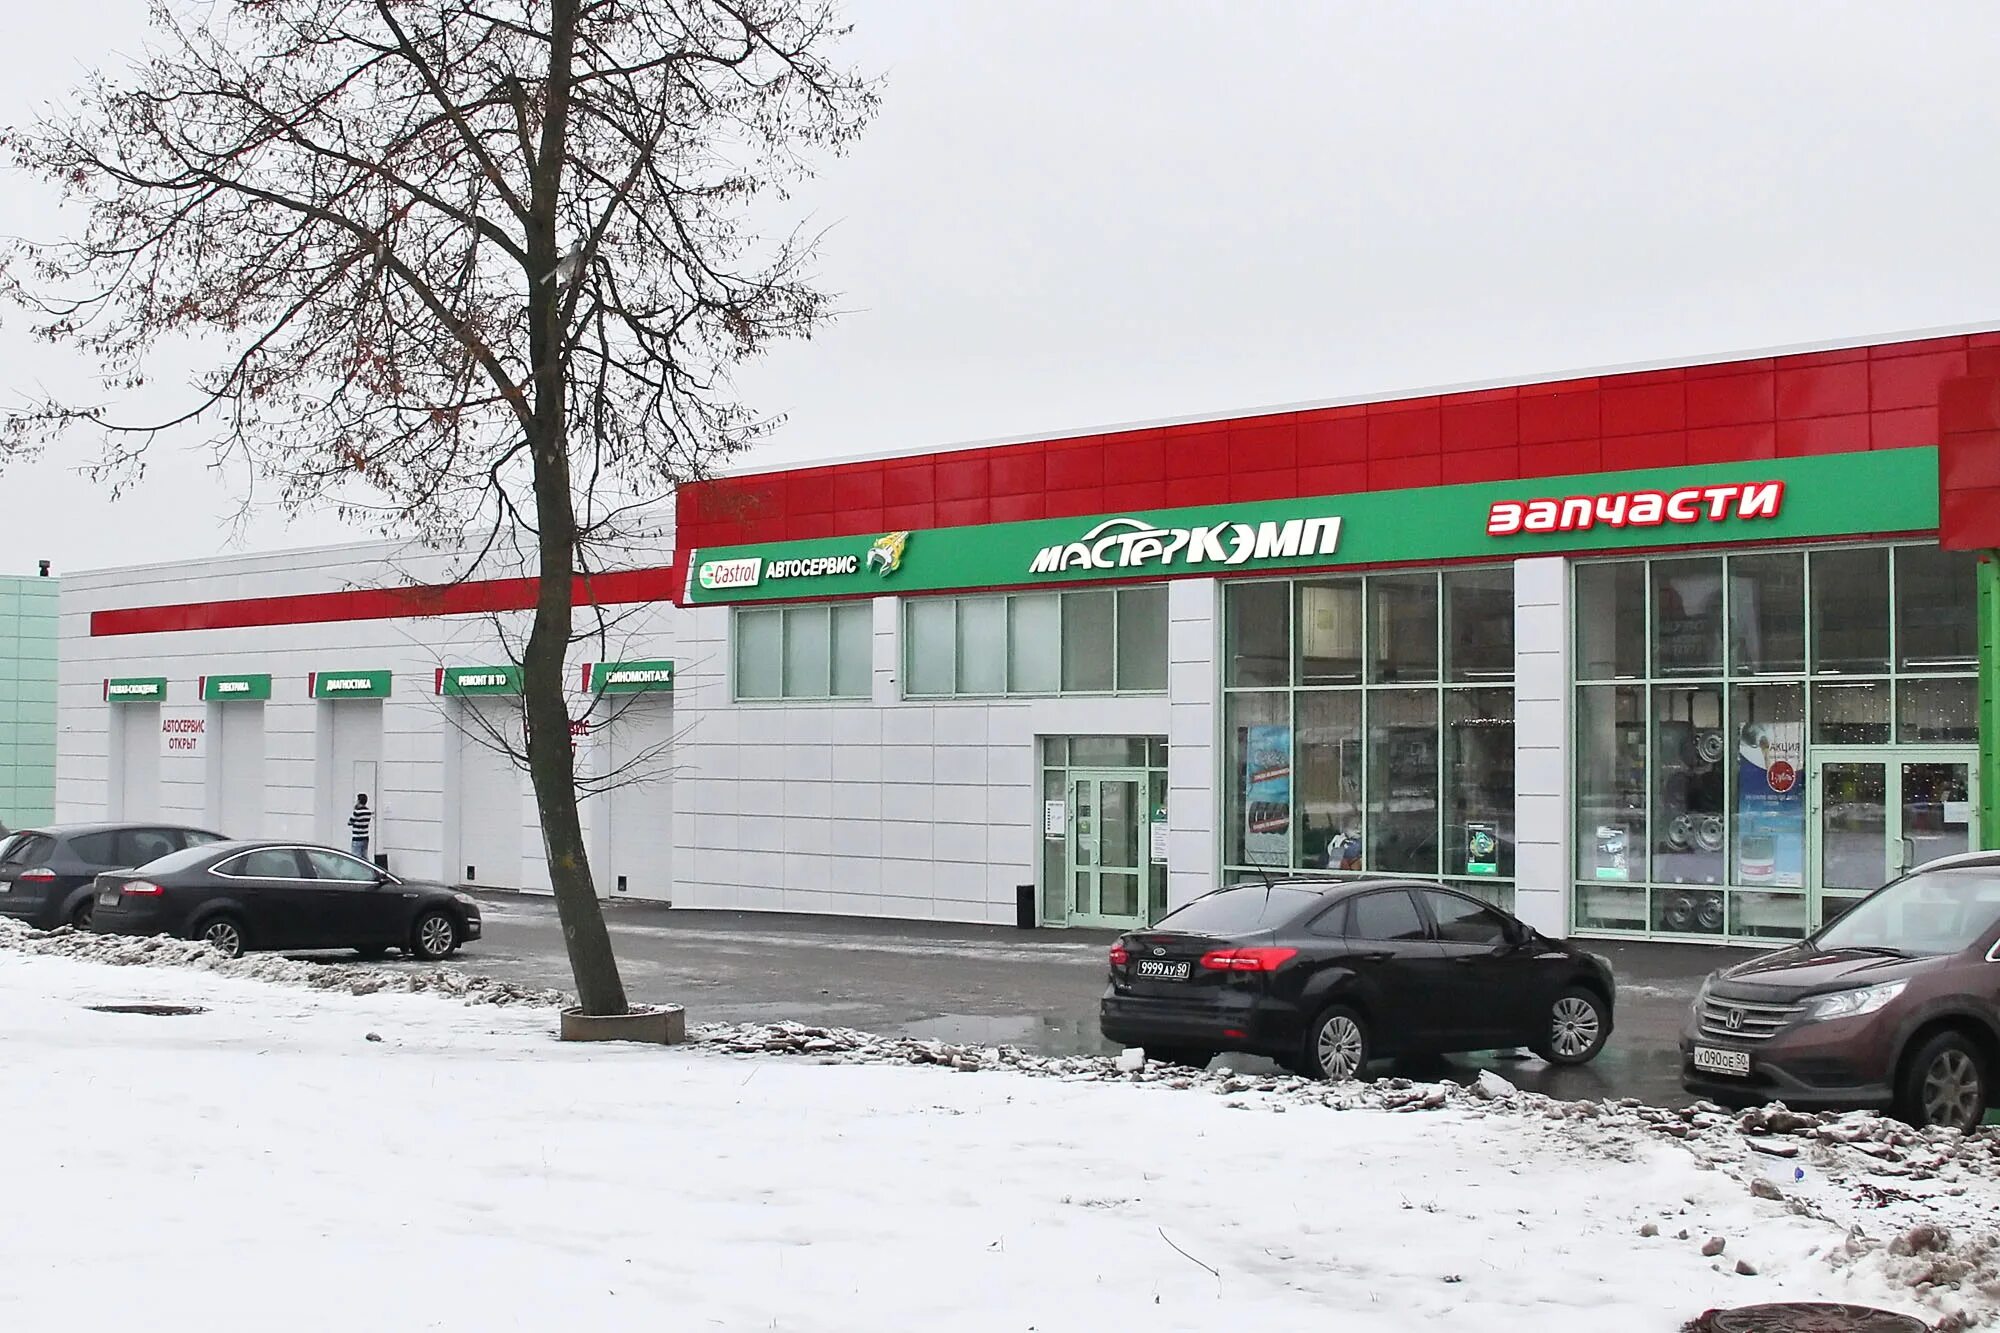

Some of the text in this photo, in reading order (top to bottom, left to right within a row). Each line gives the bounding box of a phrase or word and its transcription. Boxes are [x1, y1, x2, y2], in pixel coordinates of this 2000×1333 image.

[714, 562, 756, 584] Castrol
[766, 556, 857, 579] АВТОСЕРВИС
[326, 679, 371, 691] ДИАГНОСТИКА
[458, 675, 487, 686] РЕМОНТ
[496, 674, 506, 685] ТО
[162, 719, 205, 733] АВТОСЕРВИС
[169, 737, 197, 750] ОТКРЫТ
[1769, 742, 1800, 753] АКЦИЯ
